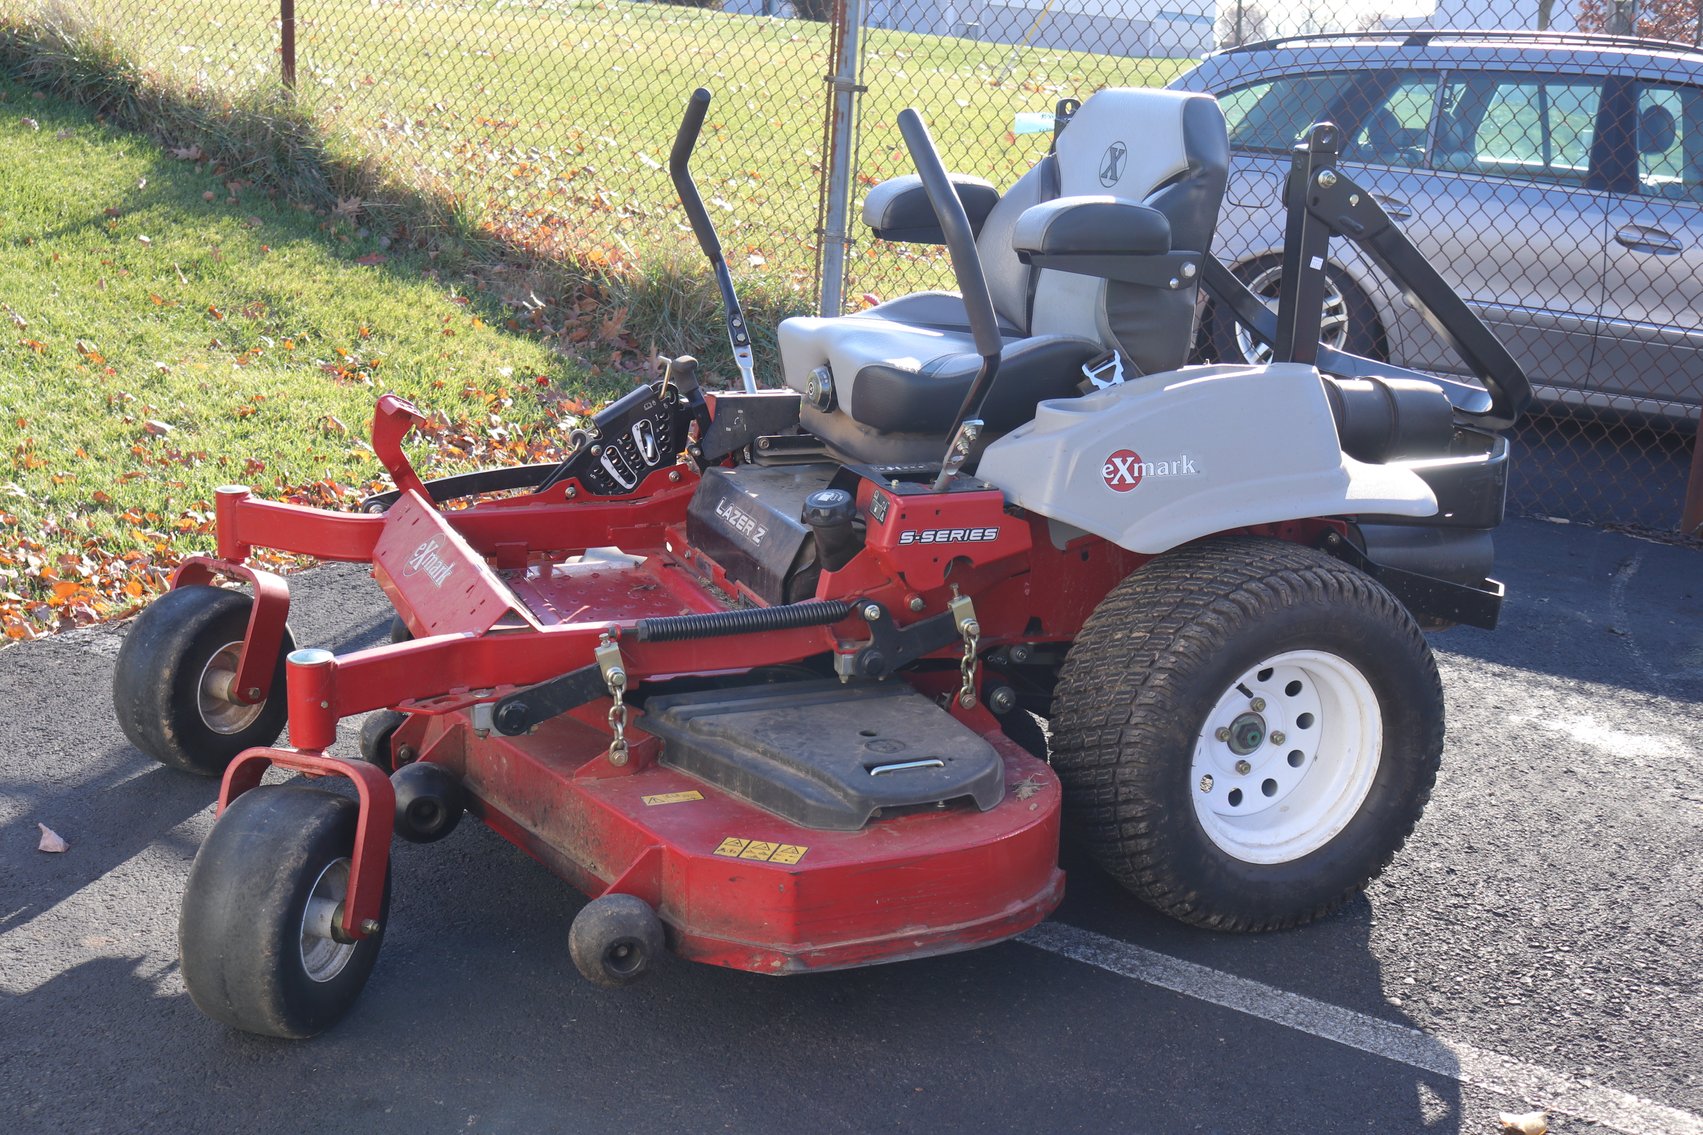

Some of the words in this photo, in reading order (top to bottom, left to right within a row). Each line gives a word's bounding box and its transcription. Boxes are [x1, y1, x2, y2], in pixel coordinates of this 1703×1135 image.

[1102, 454, 1196, 485] eXmark
[715, 498, 756, 536] LAZER
[752, 526, 766, 544] Z
[899, 528, 998, 544] S-SERIES
